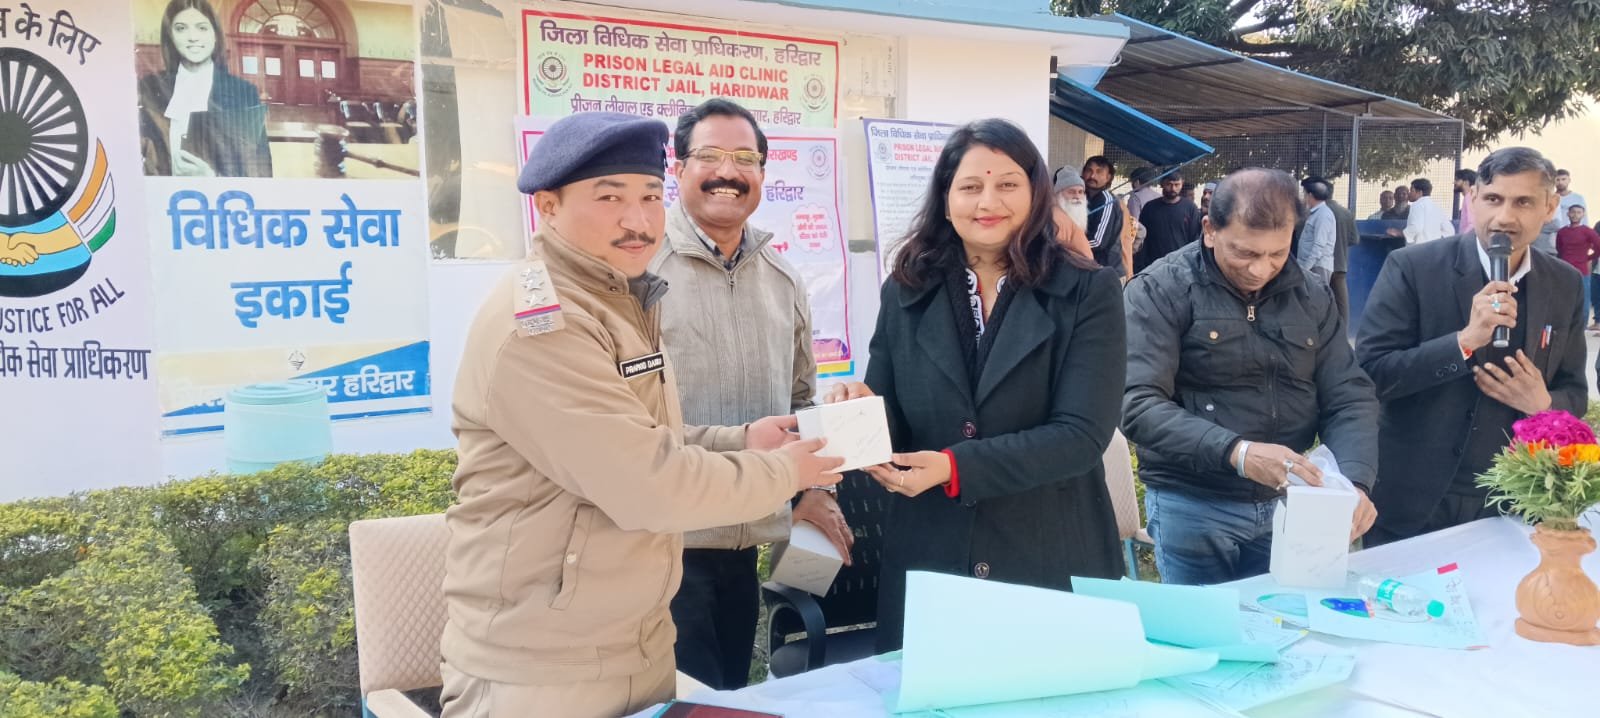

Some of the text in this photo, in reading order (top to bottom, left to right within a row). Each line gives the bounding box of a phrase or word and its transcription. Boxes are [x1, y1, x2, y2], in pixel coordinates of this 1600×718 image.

[15, 2, 42, 41] के
[48, 9, 102, 66] लिए
[539, 20, 822, 66] जिला विधिक सेवा प्राधिकरण, हरिद्वार
[583, 53, 788, 83] PRISON LEGAL AID CLINIC
[582, 72, 659, 92] DISTRICT
[665, 78, 705, 97] JAIL,
[710, 81, 789, 101] HARIDWAR
[657, 99, 698, 117] क्लीनि
[773, 106, 802, 125] हरिद्वार
[767, 149, 797, 161] राखण्ड
[764, 180, 804, 201] हरिद्वार
[167, 190, 401, 249] विधिक सेवा
[56, 297, 89, 328] FOR
[89, 277, 125, 314] ALL
[231, 261, 352, 328] इकाई
[26, 340, 58, 378] सेवा
[61, 340, 151, 380] प्राधिकरण
[343, 364, 416, 395] हरिद्वार
